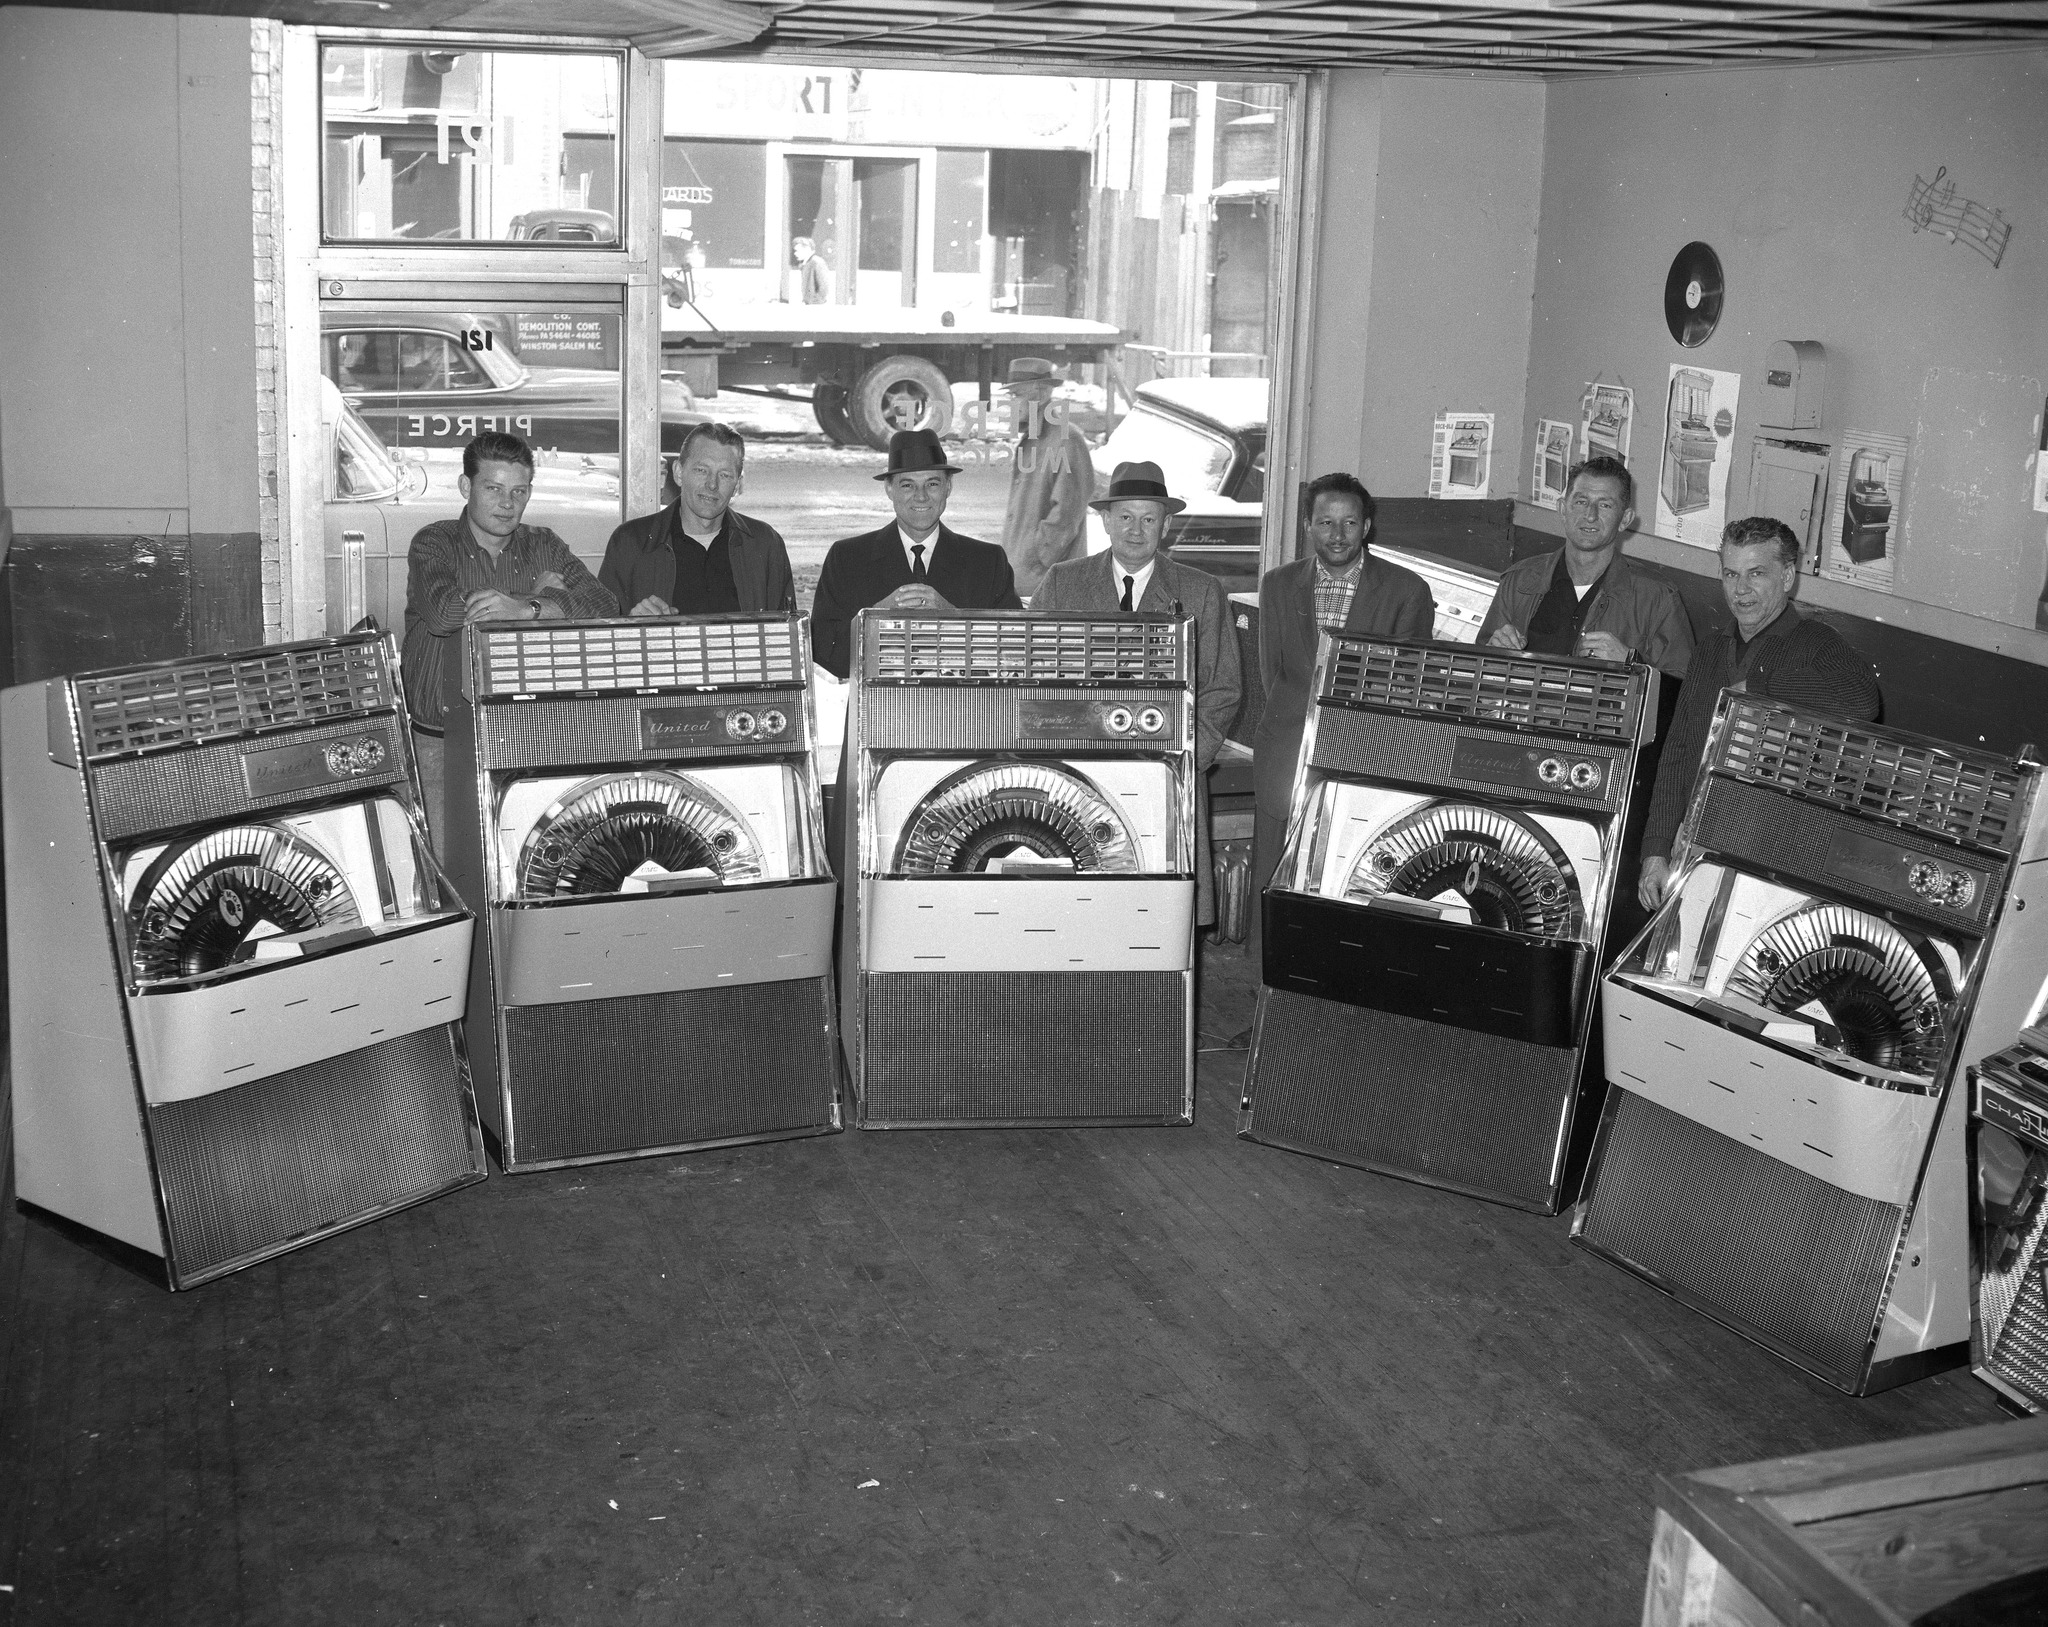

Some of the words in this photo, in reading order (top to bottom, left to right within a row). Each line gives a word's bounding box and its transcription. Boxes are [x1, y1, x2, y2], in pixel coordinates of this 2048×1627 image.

[518, 322, 572, 331] DEMOLITION
[576, 322, 602, 331] CONT.
[649, 720, 711, 734] United
